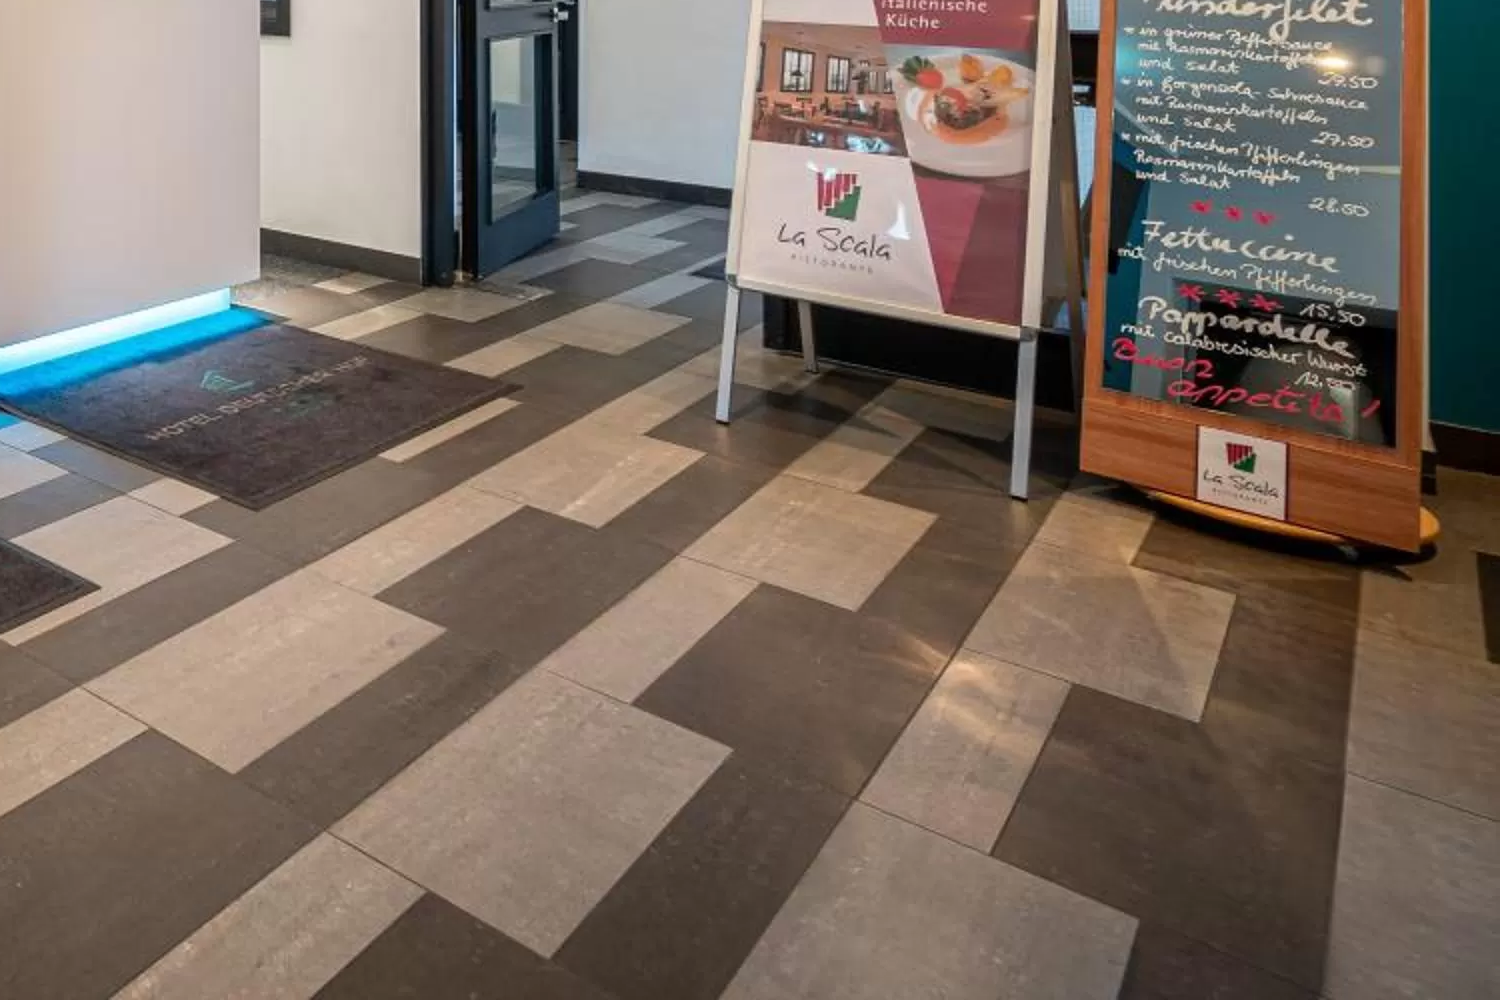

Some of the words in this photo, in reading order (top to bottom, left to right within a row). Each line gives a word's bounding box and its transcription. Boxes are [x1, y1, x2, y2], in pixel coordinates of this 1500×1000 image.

[885, 12, 942, 30] Küche
[1139, 55, 1175, 72] und
[1136, 112, 1175, 126] und
[1134, 168, 1172, 183] und
[777, 223, 806, 247] La
[816, 227, 893, 261] Scala
[1117, 243, 1148, 262] mit
[1299, 302, 1368, 329] 15.50
[1120, 322, 1155, 339] mit
[1137, 295, 1357, 360] Pappardelle
[1202, 468, 1223, 485] La
[1228, 475, 1279, 498] Scala
